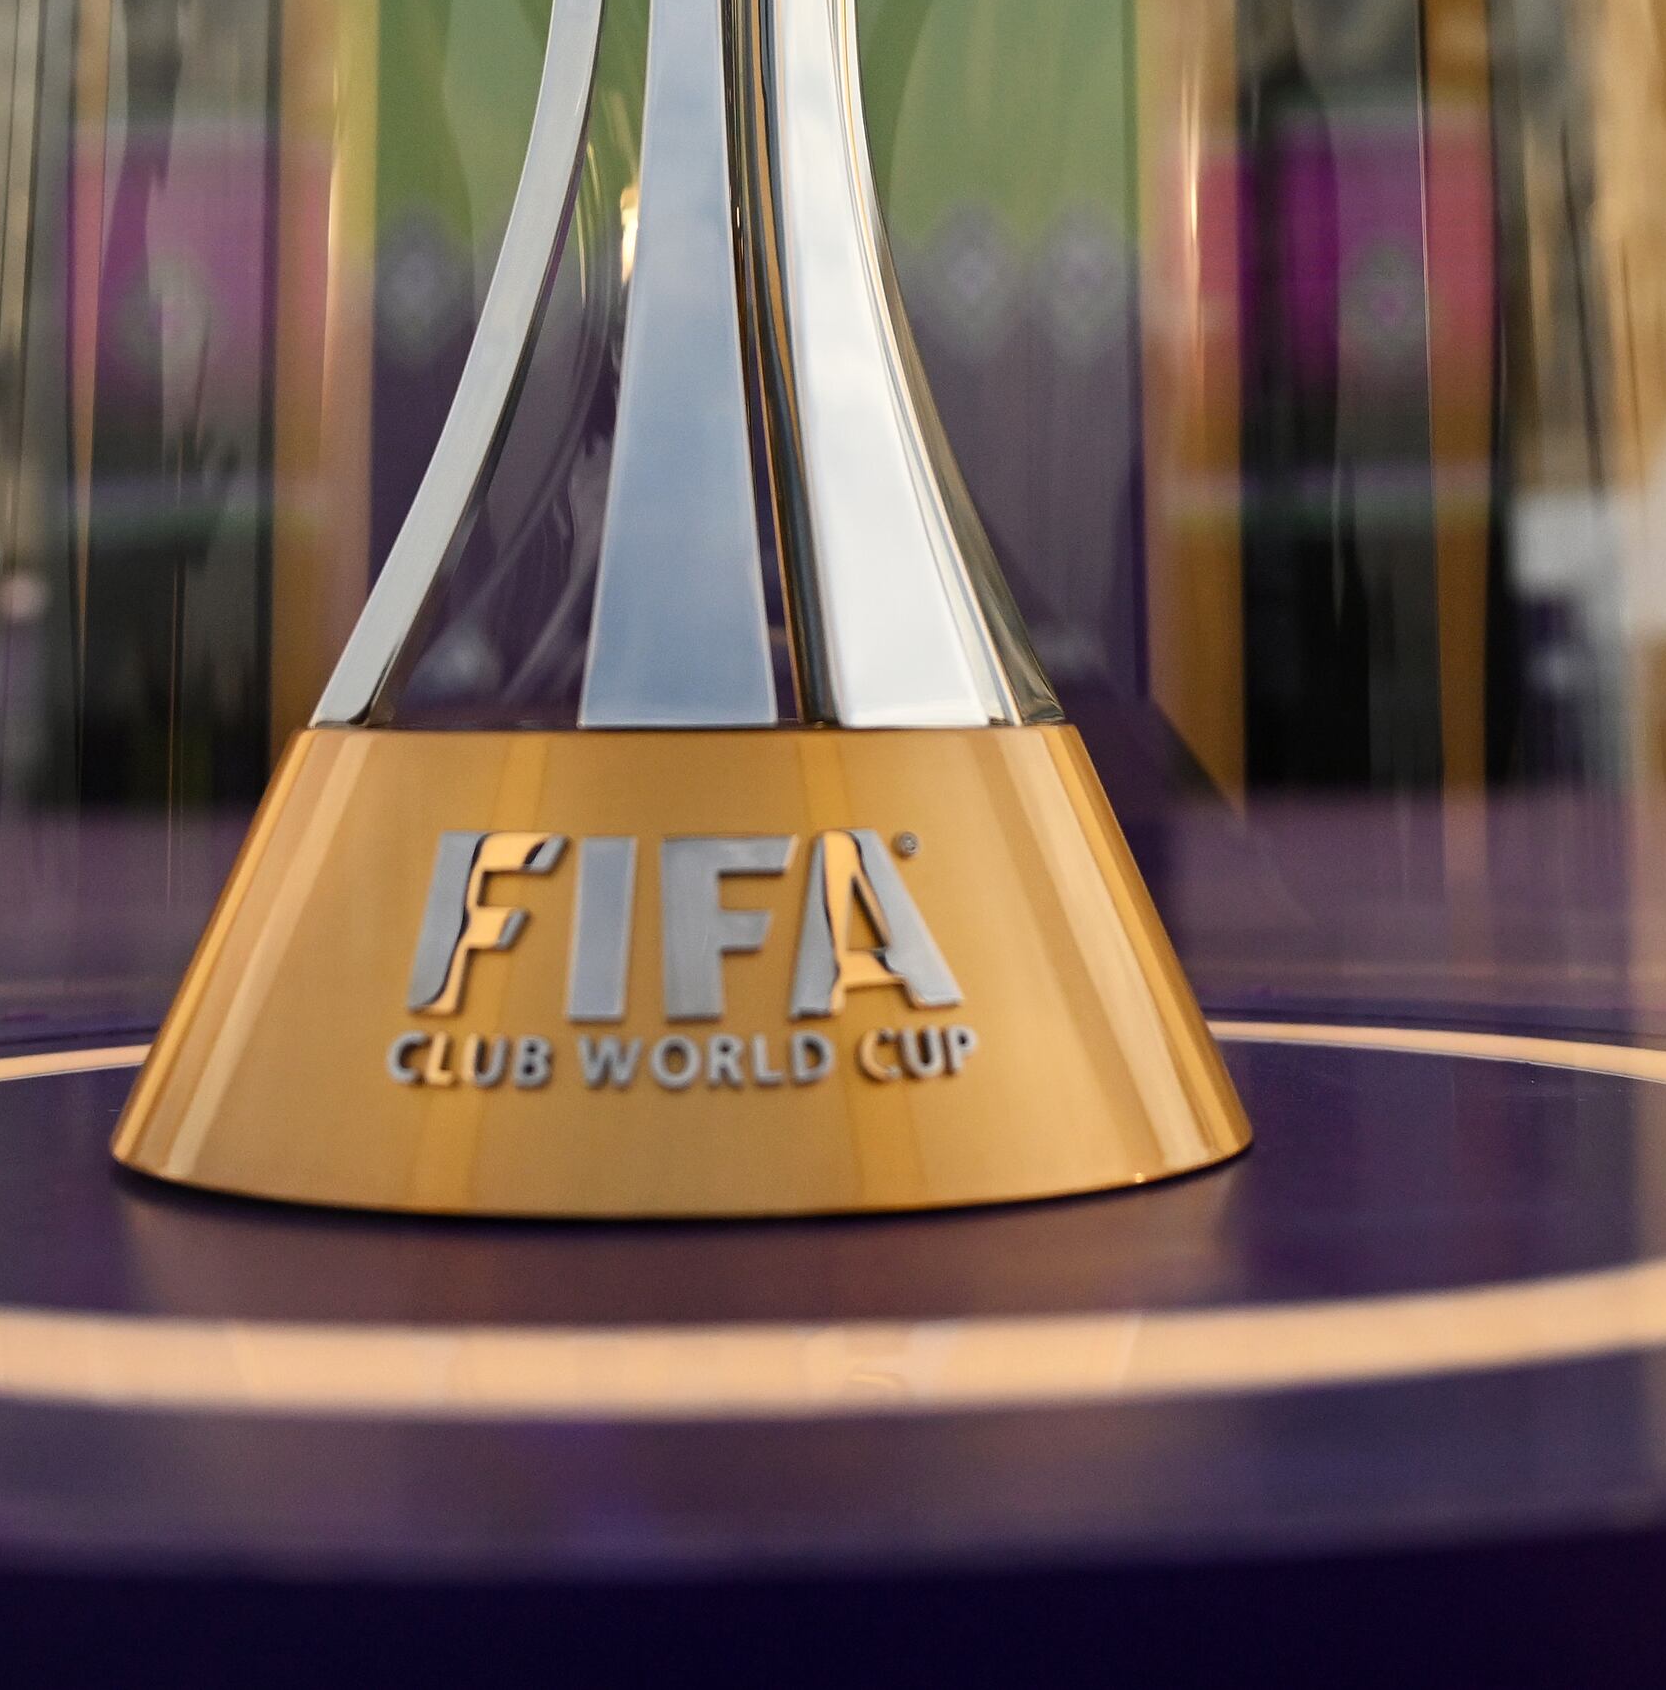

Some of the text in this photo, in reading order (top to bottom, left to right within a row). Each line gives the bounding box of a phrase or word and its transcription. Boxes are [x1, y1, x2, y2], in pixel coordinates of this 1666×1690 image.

[407, 828, 963, 1021] FIFA
[387, 1024, 978, 1090] CLUB WORLD CUP
